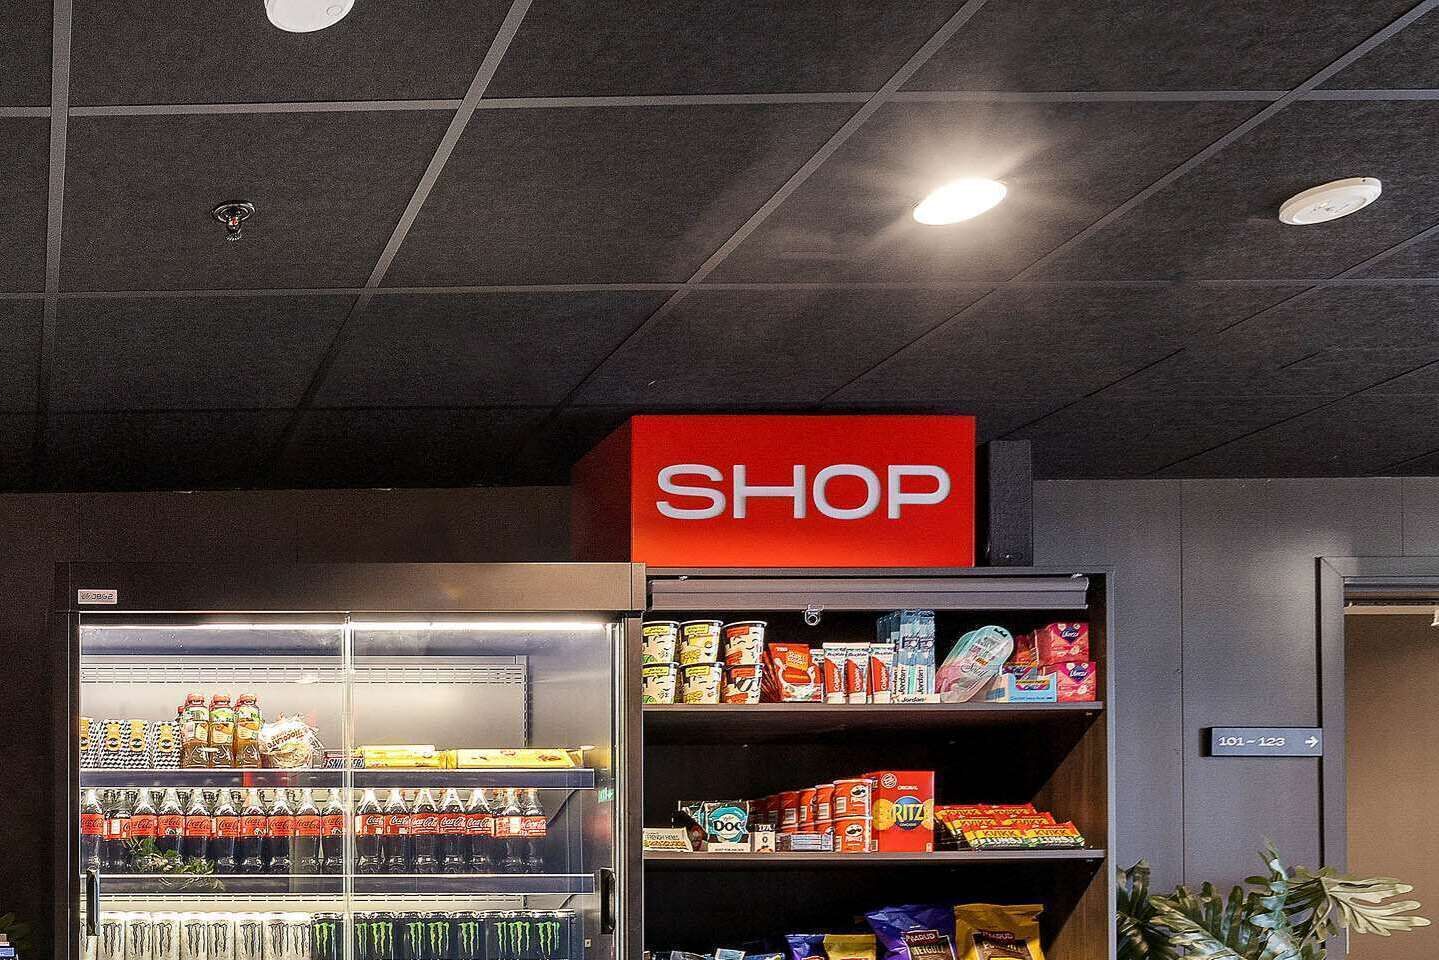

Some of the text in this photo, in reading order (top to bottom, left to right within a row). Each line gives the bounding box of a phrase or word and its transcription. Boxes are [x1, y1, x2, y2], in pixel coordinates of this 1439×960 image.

[656, 464, 952, 520] SHOP
[892, 803, 924, 823] RITZ
[1034, 829, 1068, 837] KVIKK
